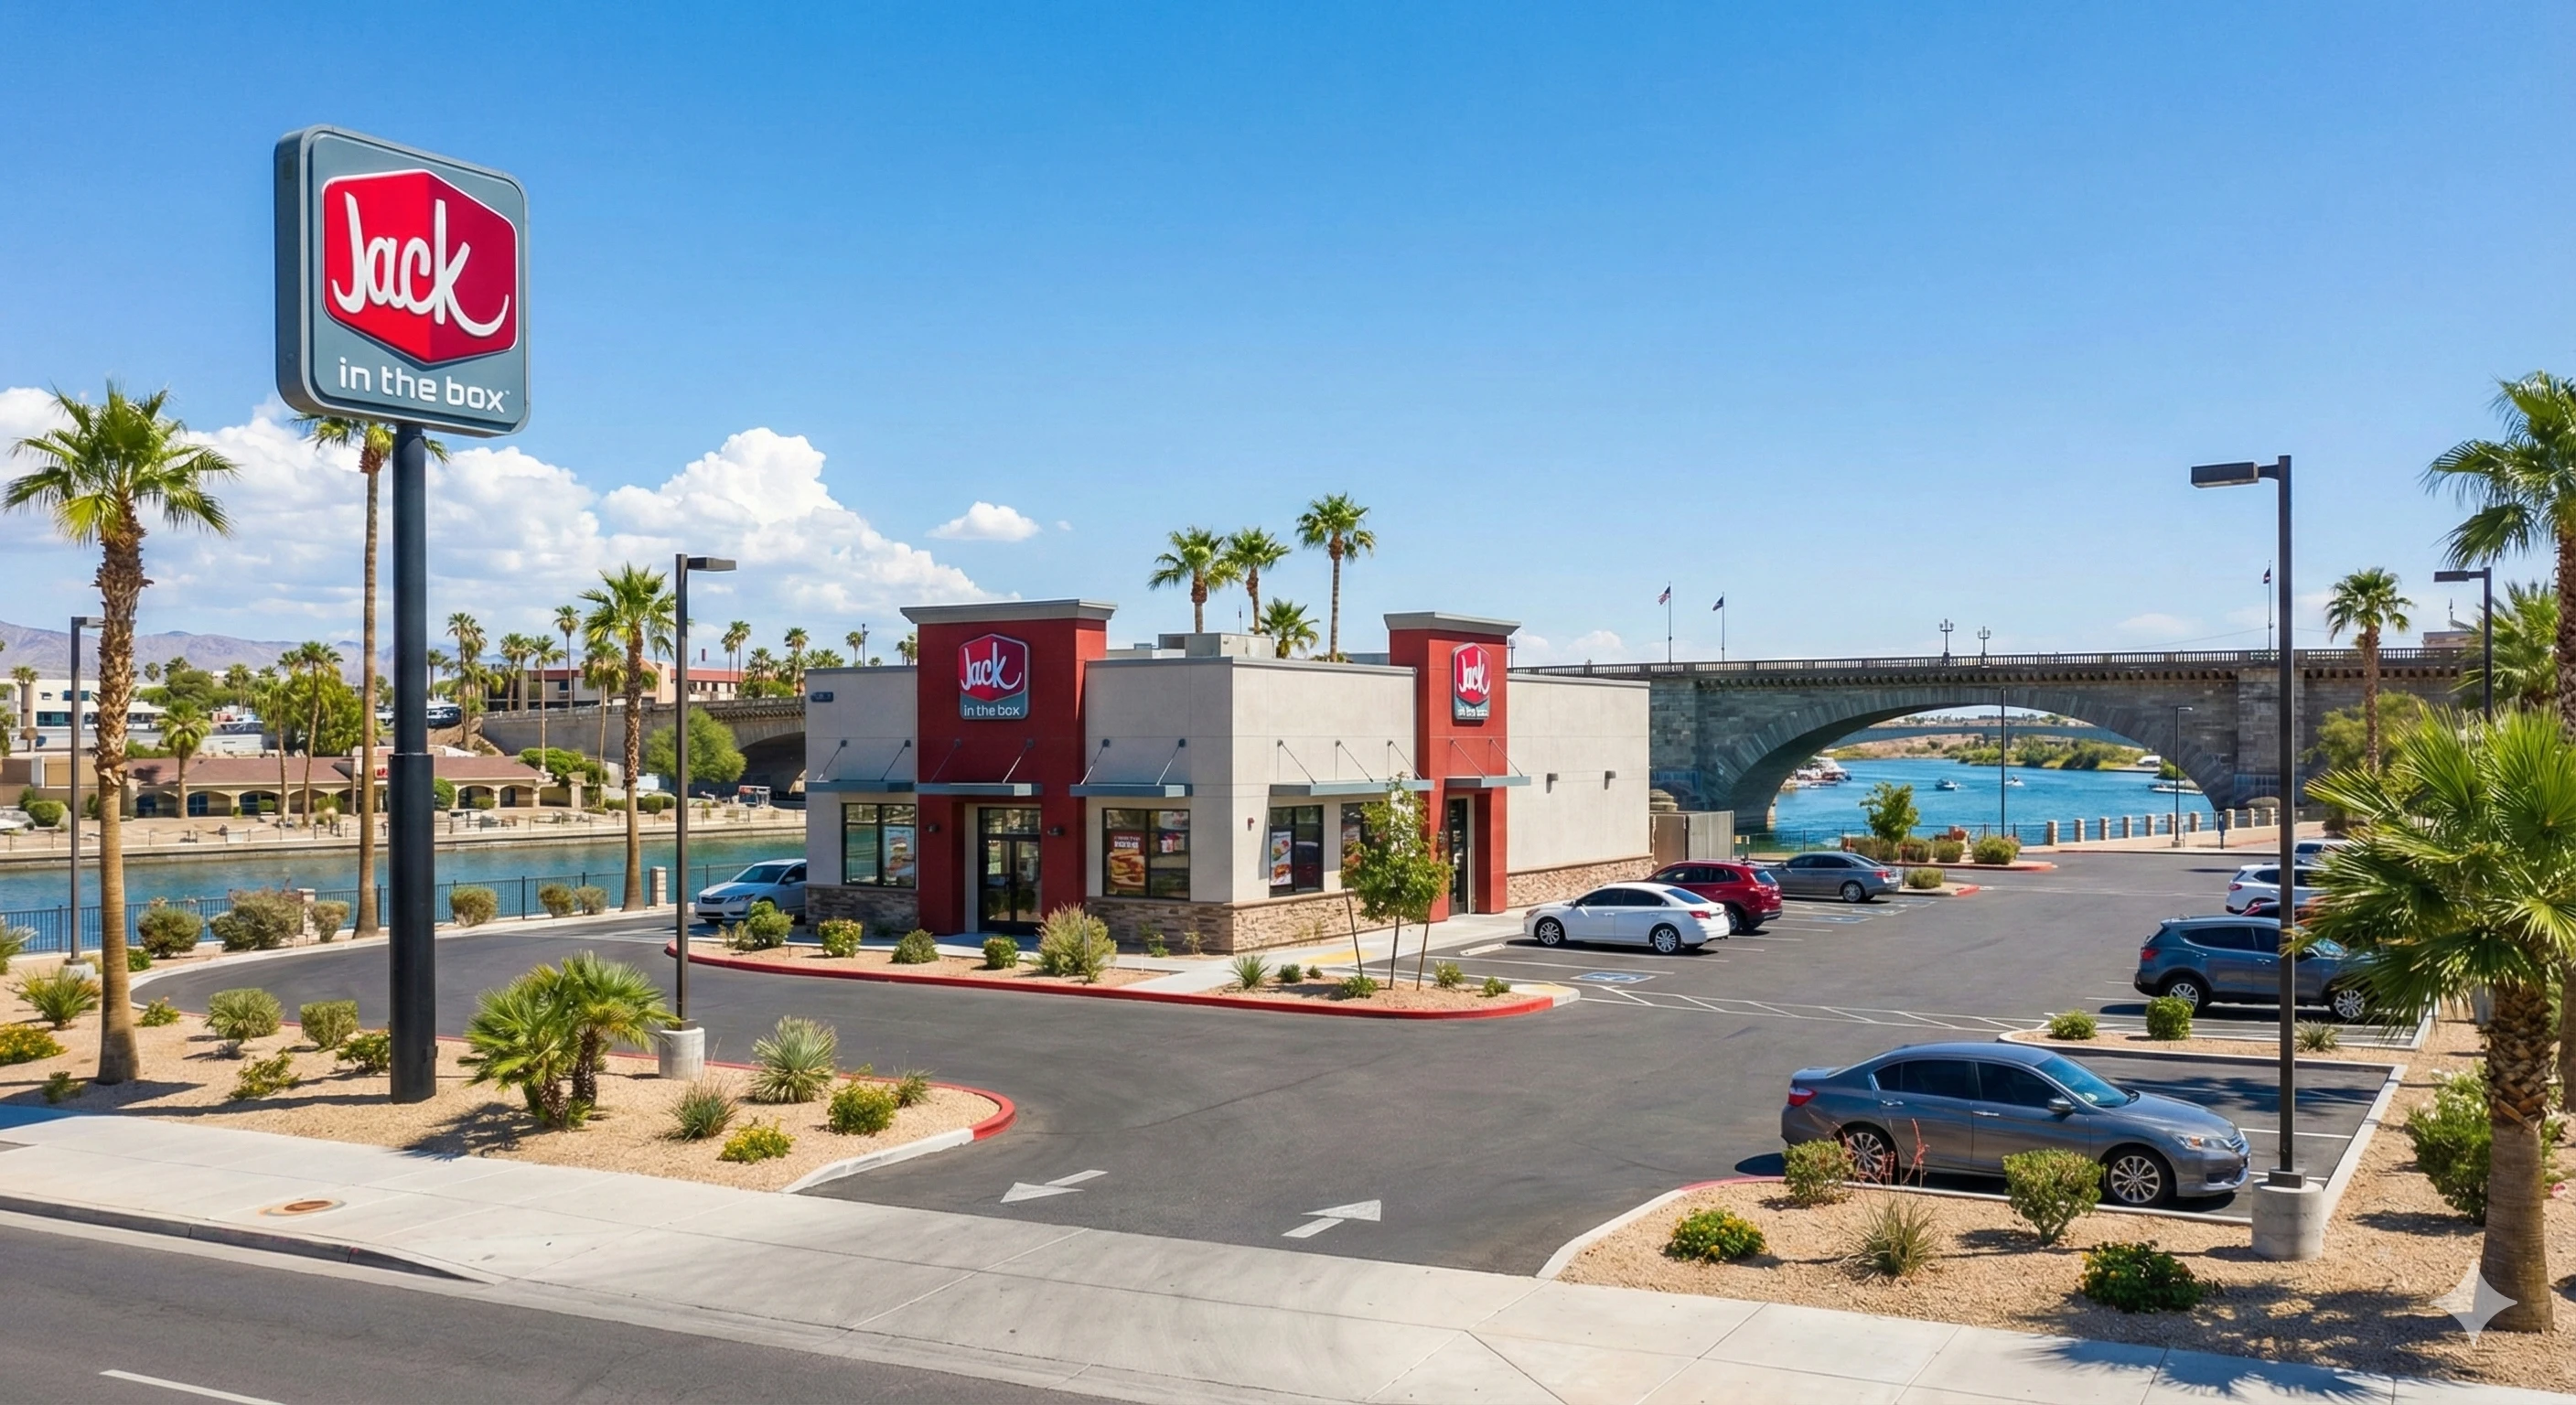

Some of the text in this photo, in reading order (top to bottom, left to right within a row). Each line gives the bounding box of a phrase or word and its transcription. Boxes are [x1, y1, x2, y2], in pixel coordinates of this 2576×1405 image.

[331, 190, 510, 338] Jack
[339, 356, 505, 413] in the box
[961, 641, 1022, 691] Jack
[1458, 650, 1491, 695] Jack
[963, 704, 974, 716] in
[976, 704, 996, 716] the
